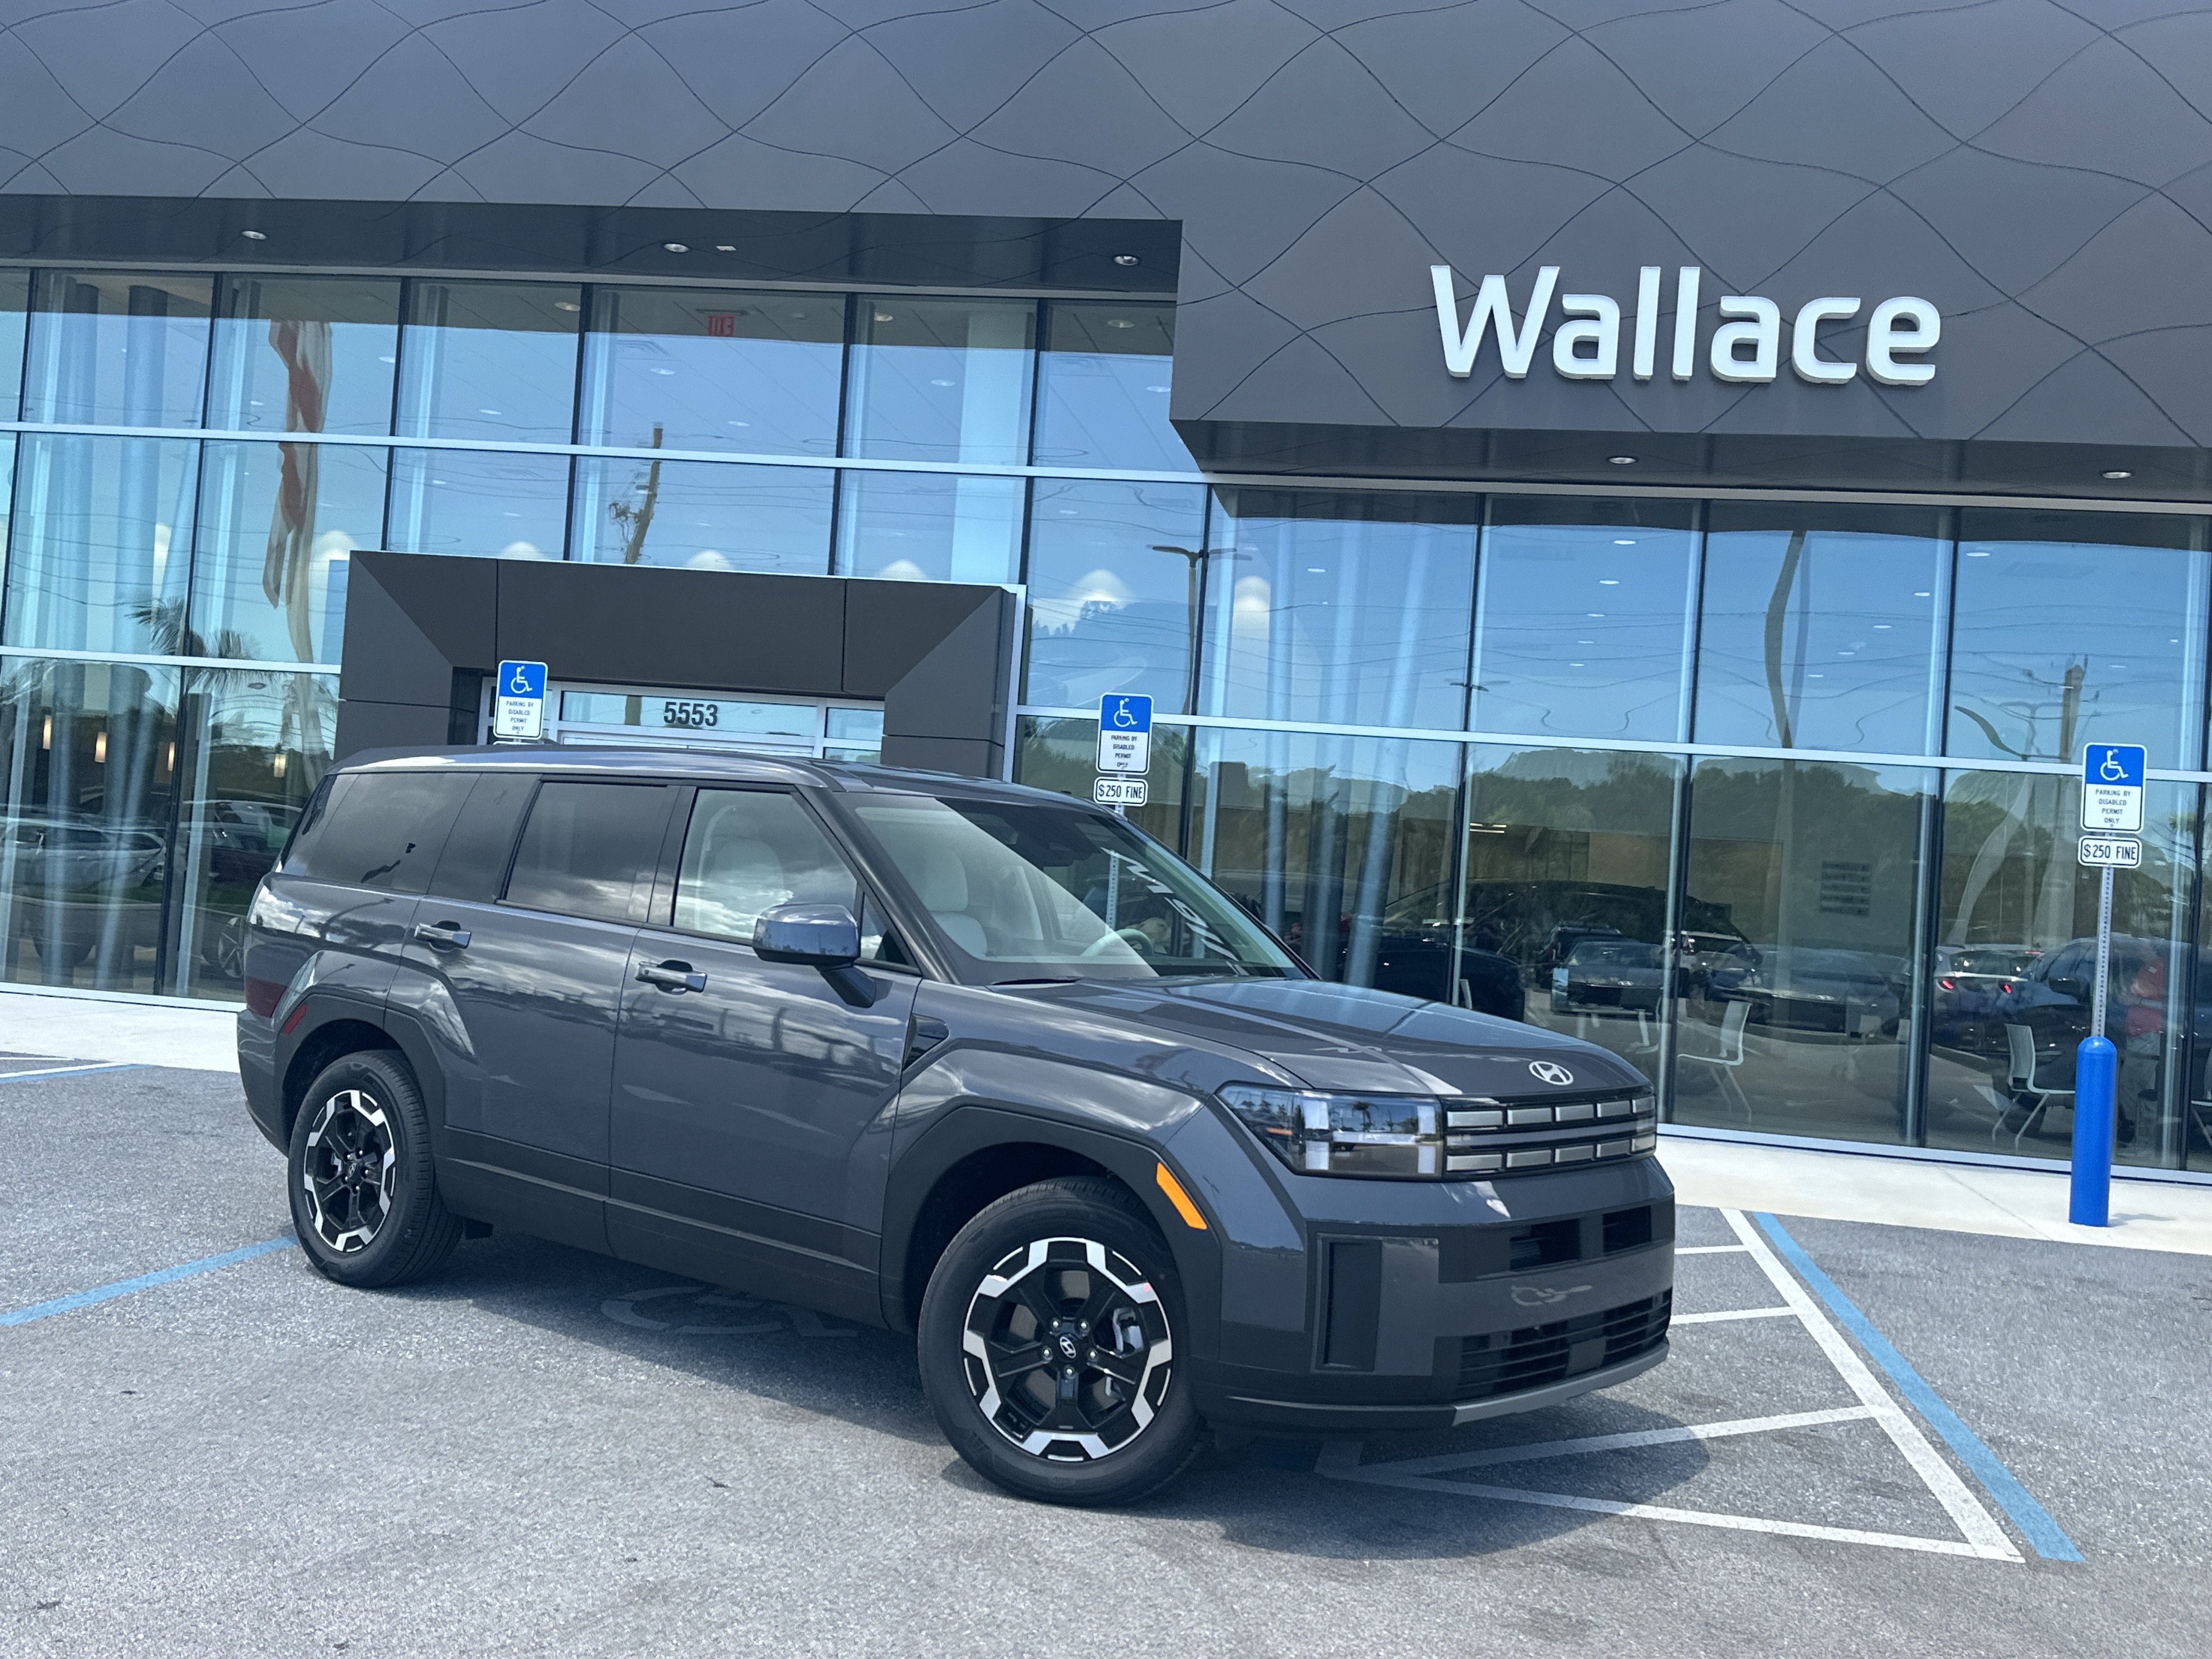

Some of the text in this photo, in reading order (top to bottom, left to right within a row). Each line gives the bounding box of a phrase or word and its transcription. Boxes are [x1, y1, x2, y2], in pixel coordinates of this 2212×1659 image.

[1430, 265, 1942, 386] Wallace
[663, 701, 718, 726] 5553
[1098, 783, 1143, 799] $250 FINE
[2084, 843, 2136, 860] $250 FINE
